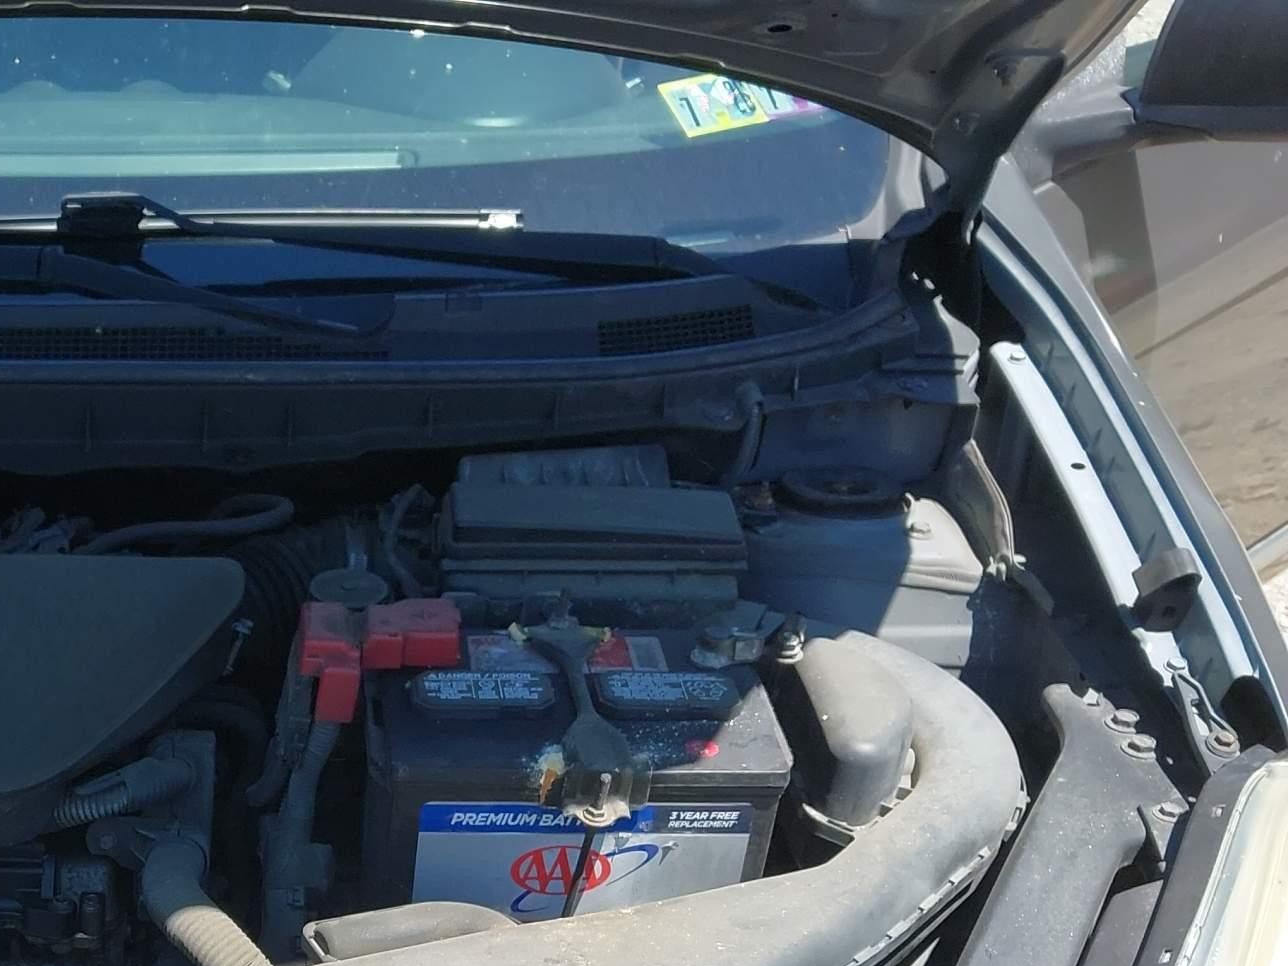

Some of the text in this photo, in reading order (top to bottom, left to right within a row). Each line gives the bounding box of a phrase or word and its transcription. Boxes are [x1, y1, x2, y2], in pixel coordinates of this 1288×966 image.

[438, 672, 481, 681] DANGER
[492, 672, 531, 681] POISON
[450, 812, 537, 826] PREMIUM
[669, 811, 741, 820] 3 YEAR FREE
[518, 847, 604, 895] AAA
